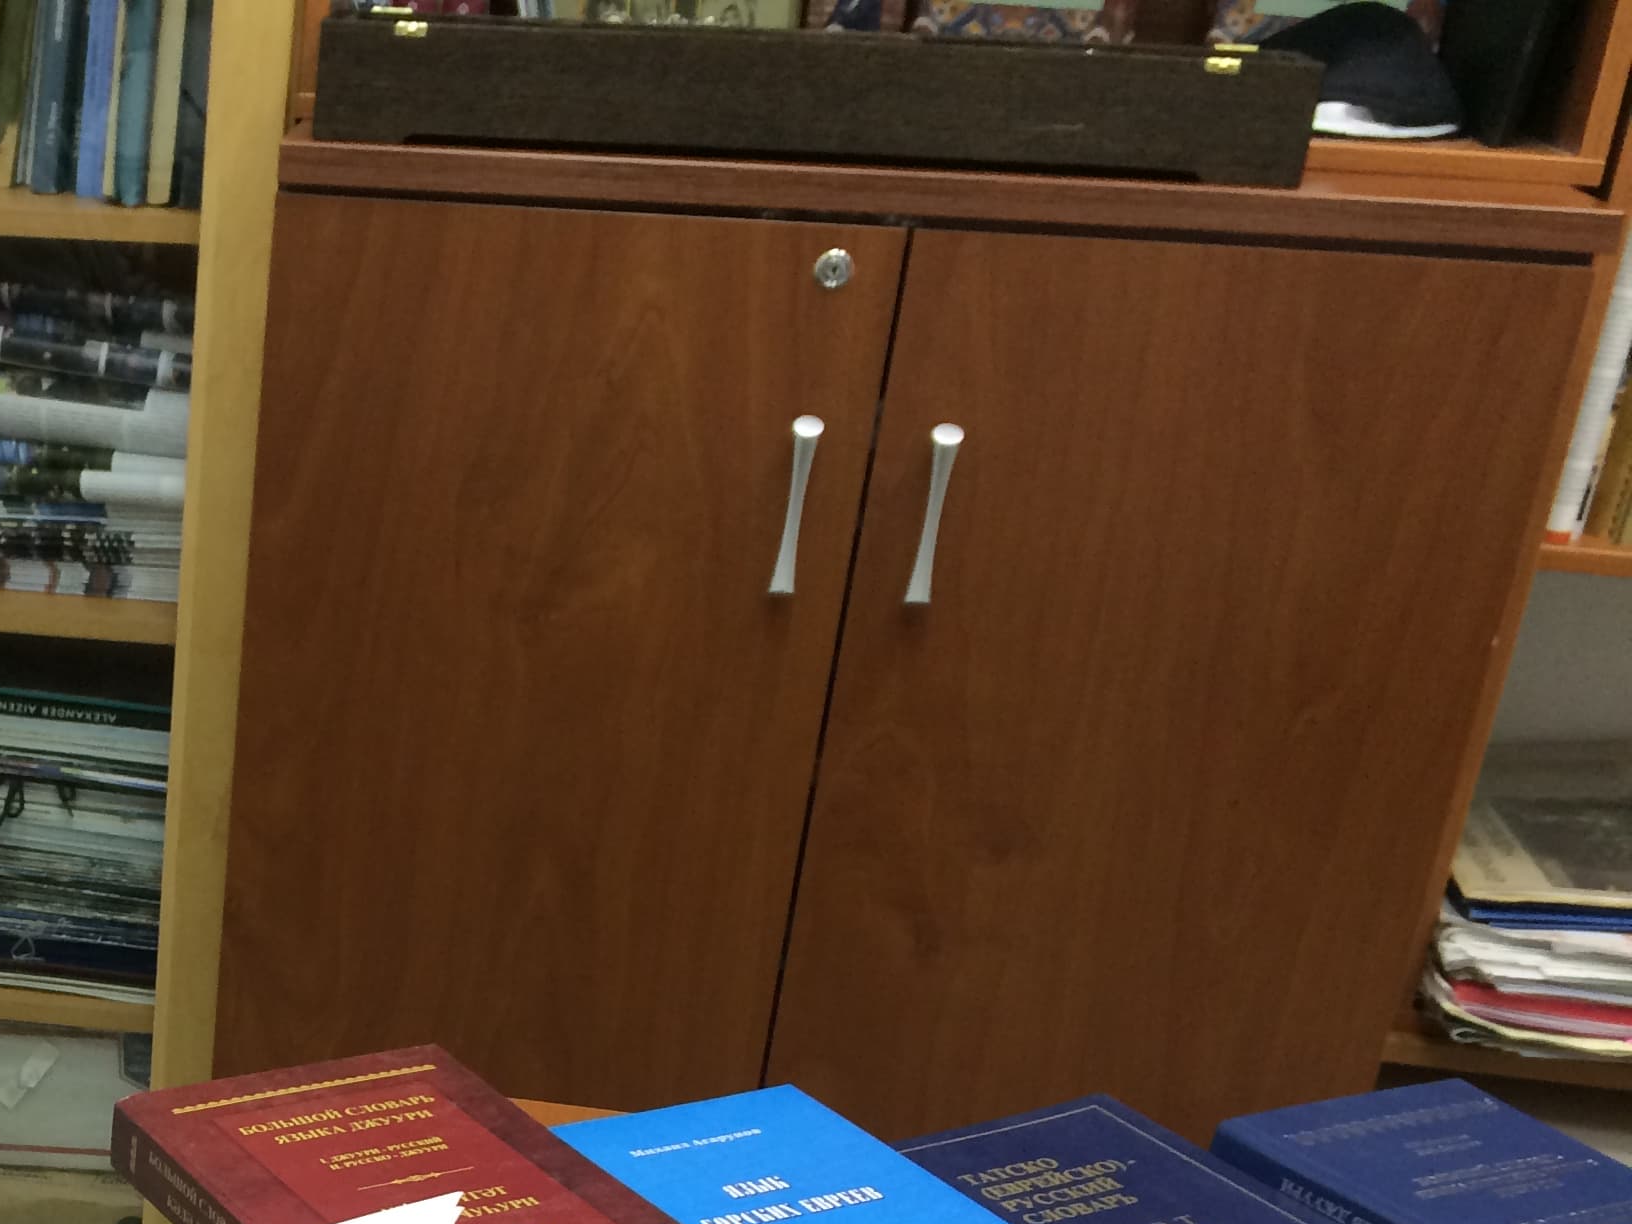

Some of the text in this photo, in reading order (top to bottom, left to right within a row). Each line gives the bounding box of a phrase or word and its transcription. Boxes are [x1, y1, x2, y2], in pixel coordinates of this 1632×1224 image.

[42, 706, 117, 723] ALEXANDER
[238, 1095, 435, 1136] БОЛЬШОЙ СЛОВАРЬ
[274, 1109, 434, 1145] ЯЗЫКА ДЖУУРИ
[331, 1147, 381, 1163] ДЖУУРИ
[387, 1136, 443, 1152] РУССКИЙ
[342, 1154, 392, 1169] РУССКО
[400, 1144, 448, 1159] ДЖУУРИ
[957, 1157, 1059, 1186] ТАТСКО
[722, 1175, 791, 1199] ЯЗЫК
[797, 1185, 886, 1215] ЕВРЕЕВ
[1000, 1177, 1124, 1213] РУССКИЙ
[1022, 1193, 1139, 1224] СЛОВАРЬ
